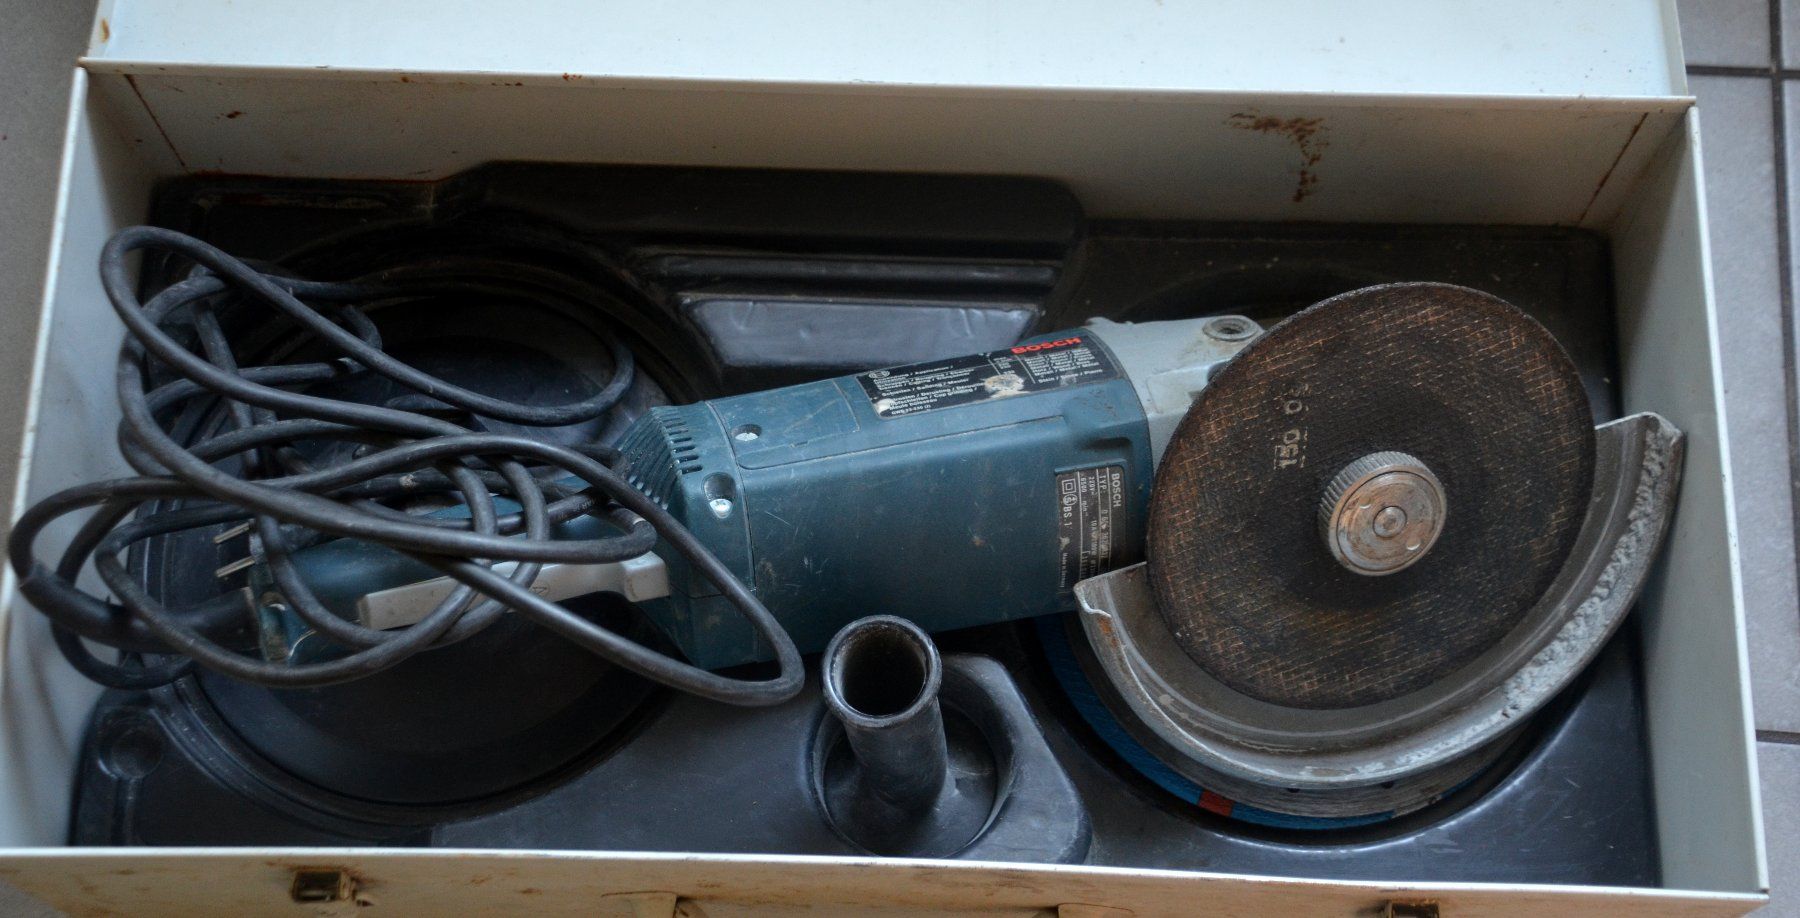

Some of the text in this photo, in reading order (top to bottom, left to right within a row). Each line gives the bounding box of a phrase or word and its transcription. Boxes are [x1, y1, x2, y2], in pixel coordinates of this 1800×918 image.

[1011, 336, 1082, 354] BOSCH
[1099, 475, 1108, 494] TYP:
[1111, 473, 1122, 508] BOSCH
